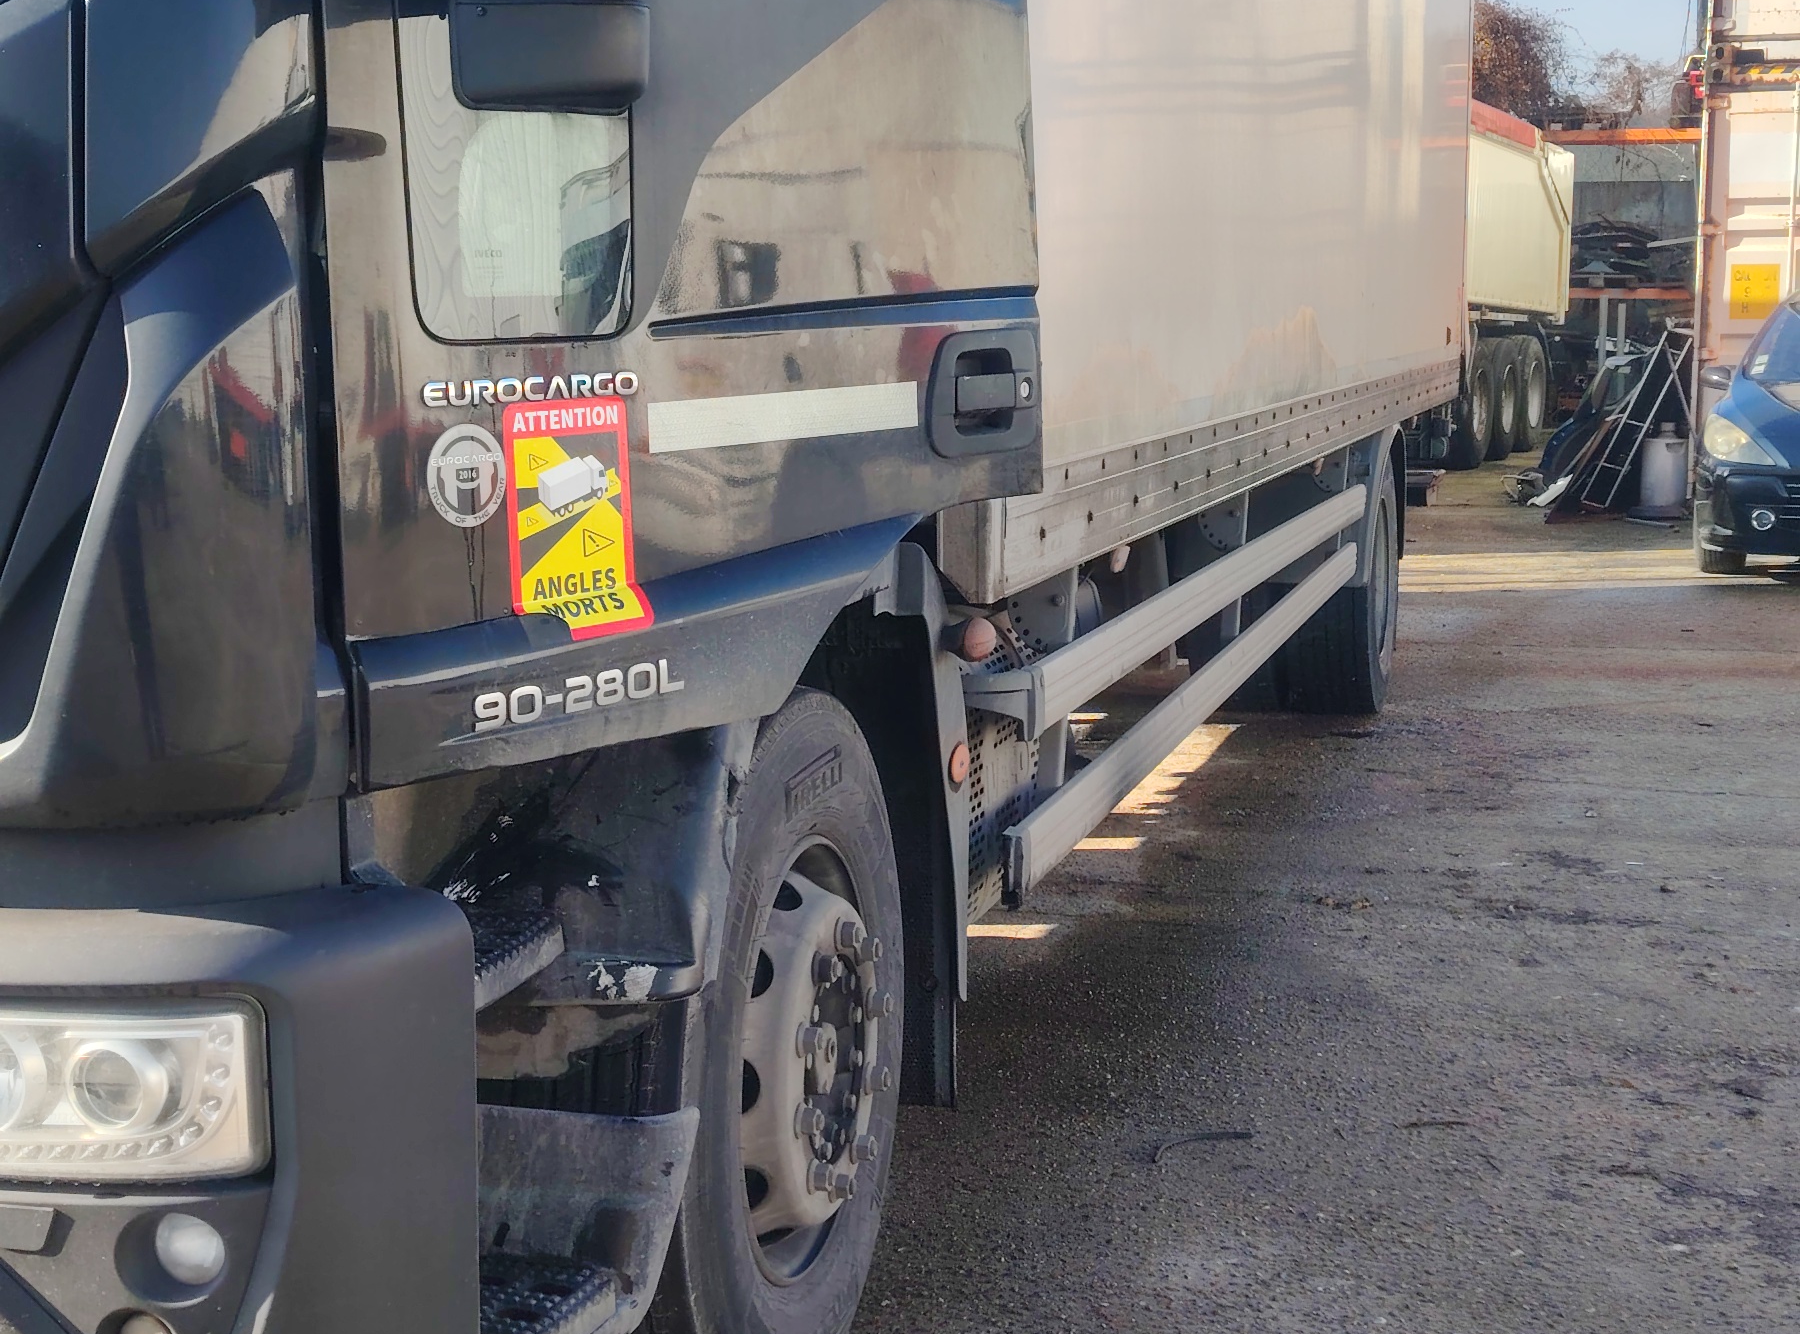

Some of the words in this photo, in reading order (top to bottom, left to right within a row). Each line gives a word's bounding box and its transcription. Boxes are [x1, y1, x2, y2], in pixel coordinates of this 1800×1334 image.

[474, 249, 502, 258] IVECO
[423, 371, 639, 407] EUROCARGO
[512, 405, 619, 433] ATTENTION
[430, 452, 502, 466] EUROCARGO
[458, 469, 477, 480] 2016
[430, 484, 450, 516] TRUCK
[455, 516, 467, 524] OF
[473, 508, 490, 522] THE
[493, 477, 505, 505] YEAR
[533, 567, 616, 601] ANGLES
[541, 592, 625, 619] MORTS
[473, 658, 685, 733] 90-280L
[783, 743, 842, 824] PIRELLI
